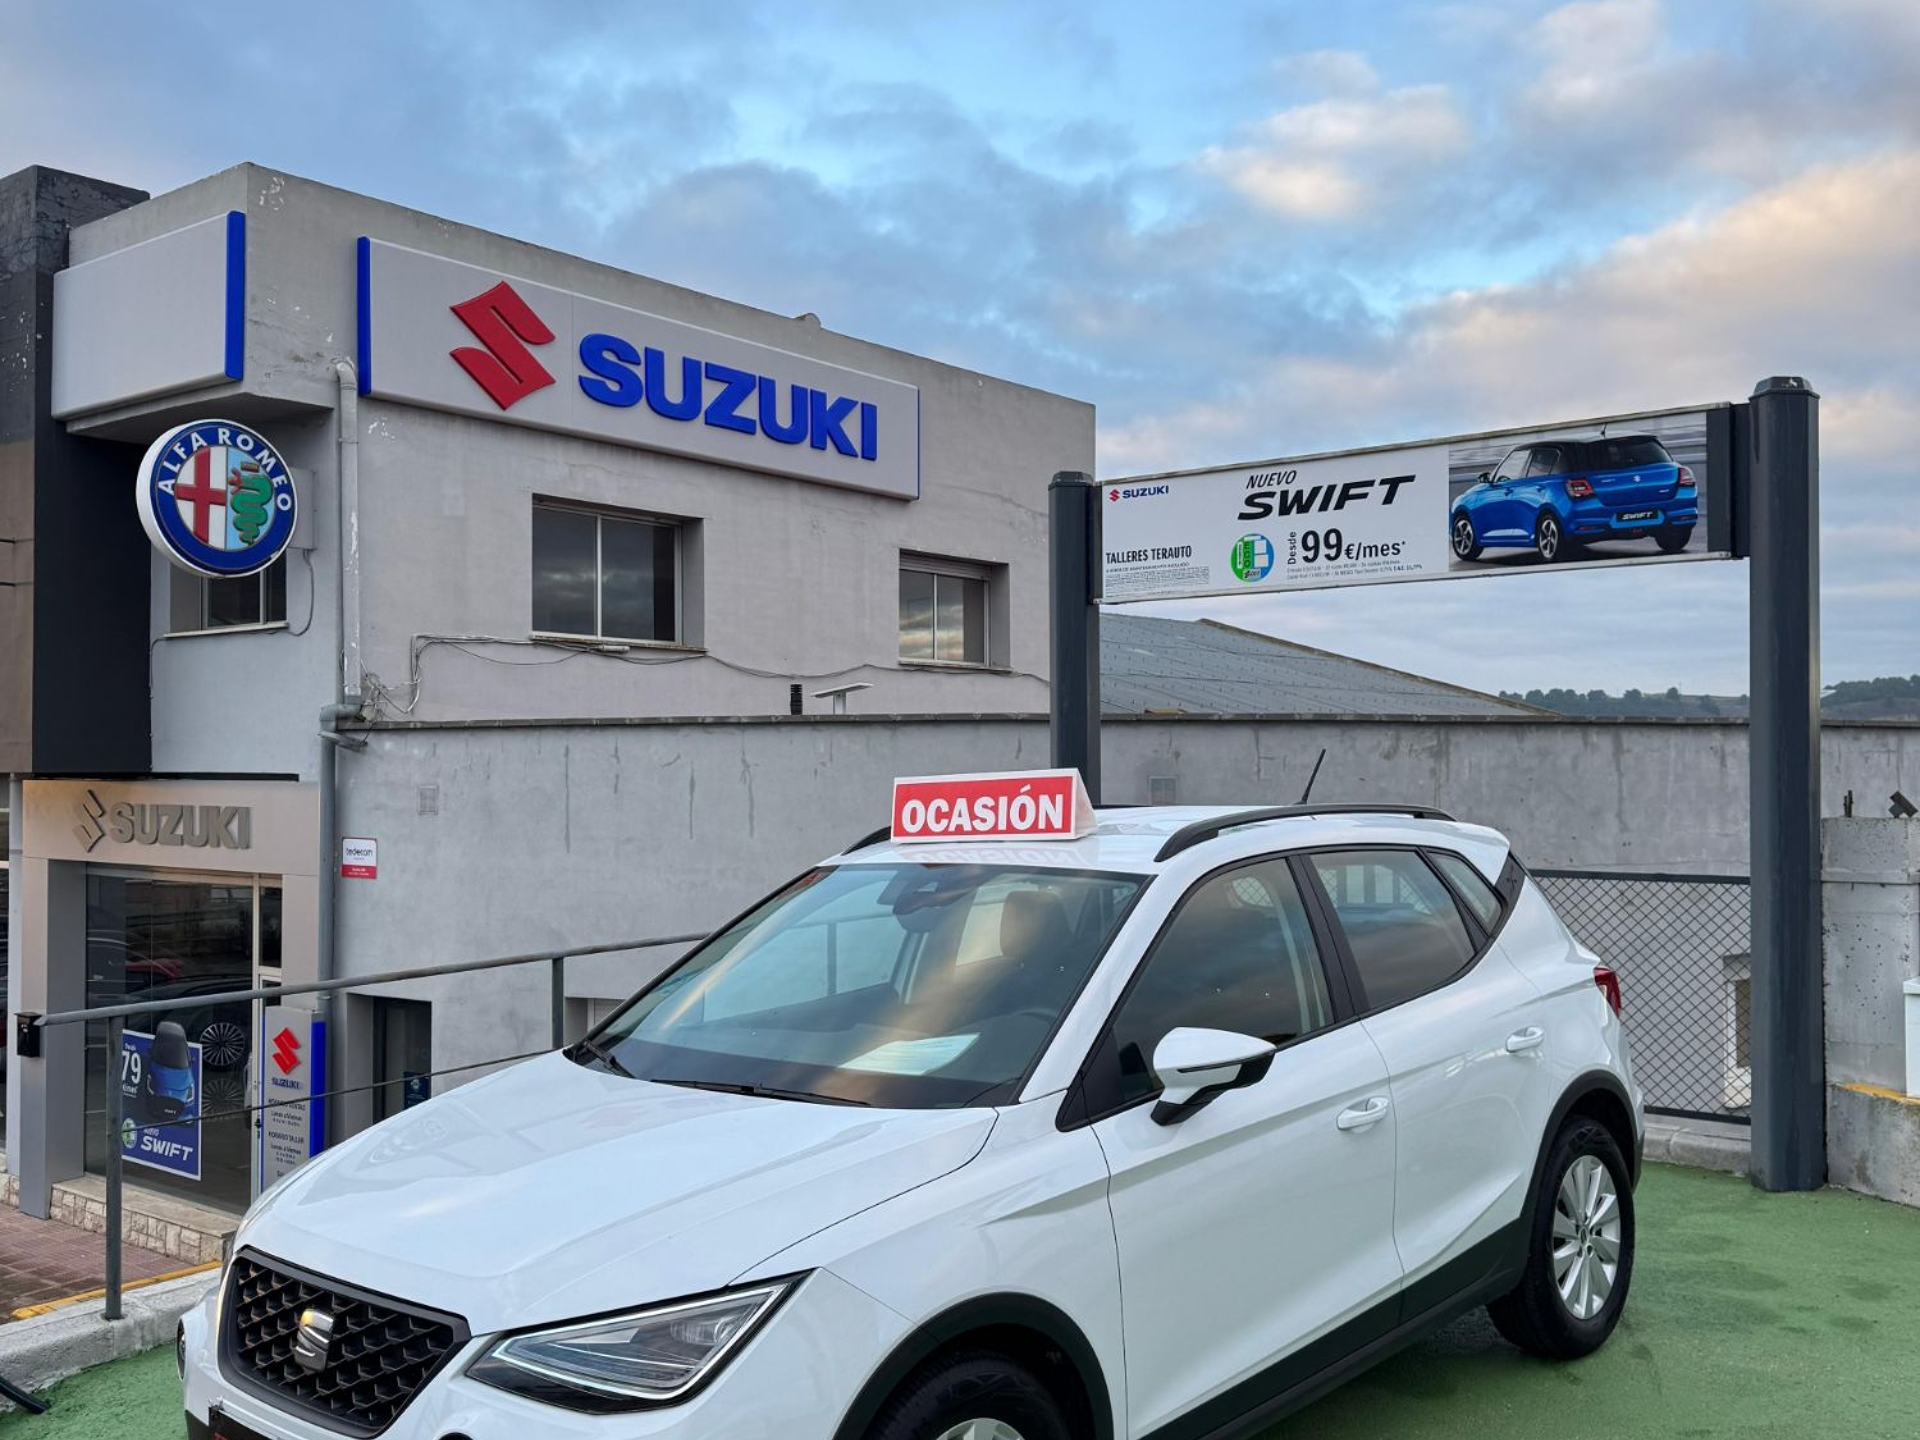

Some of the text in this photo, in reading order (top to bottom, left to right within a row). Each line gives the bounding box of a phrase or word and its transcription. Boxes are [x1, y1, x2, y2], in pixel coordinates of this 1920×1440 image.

[578, 333, 878, 461] SUZUKI
[158, 427, 292, 511] ALFA ROMEO
[1246, 469, 1297, 490] NUEVO
[1122, 485, 1169, 499] SUZUKI
[1238, 474, 1416, 521] SWIFT
[1106, 545, 1192, 564] TALLERES TERAUTO
[1287, 531, 1297, 565] Desde
[109, 801, 252, 850] SUZUKI
[902, 784, 1063, 833] OCASIÓN
[122, 1050, 142, 1085] 79
[271, 1077, 300, 1090] SUZUKI
[141, 1135, 194, 1161] SWIFT
